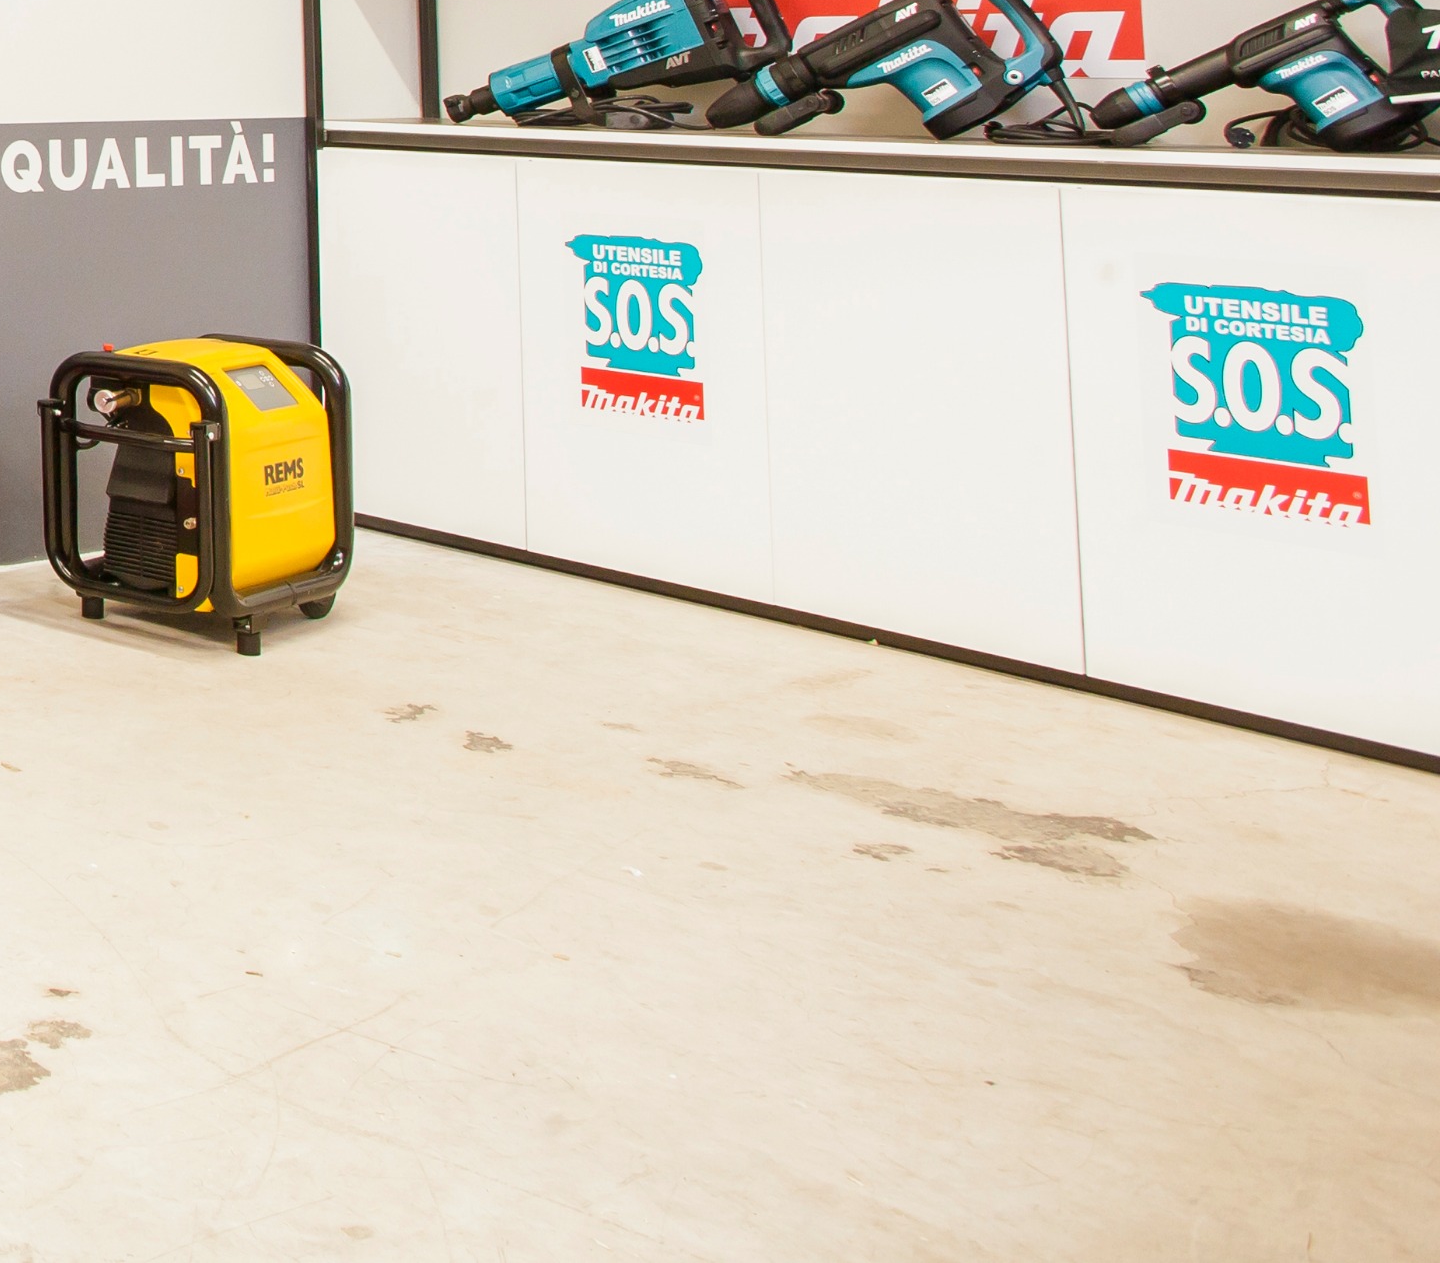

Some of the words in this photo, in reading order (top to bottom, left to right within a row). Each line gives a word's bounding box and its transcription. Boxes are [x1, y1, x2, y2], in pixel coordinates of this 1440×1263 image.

[609, 0, 671, 28] makita
[894, 1, 918, 23] AVT
[1293, 13, 1318, 31] AVT
[665, 51, 691, 71] AVT
[877, 44, 934, 74] makita
[0, 121, 276, 194] QUALITÀ!
[592, 243, 683, 266] UTENSILE
[593, 261, 608, 274] DI
[611, 262, 683, 281] CORTESIA
[584, 275, 696, 358] S.O.S.
[1183, 295, 1329, 327] UTENSILE
[1185, 316, 1209, 333] DI
[1213, 320, 1332, 346] CORTESIA
[581, 383, 705, 424] makita
[1171, 335, 1354, 445] S.O.S.
[263, 457, 304, 486] REMS
[1168, 469, 1372, 528] makita
